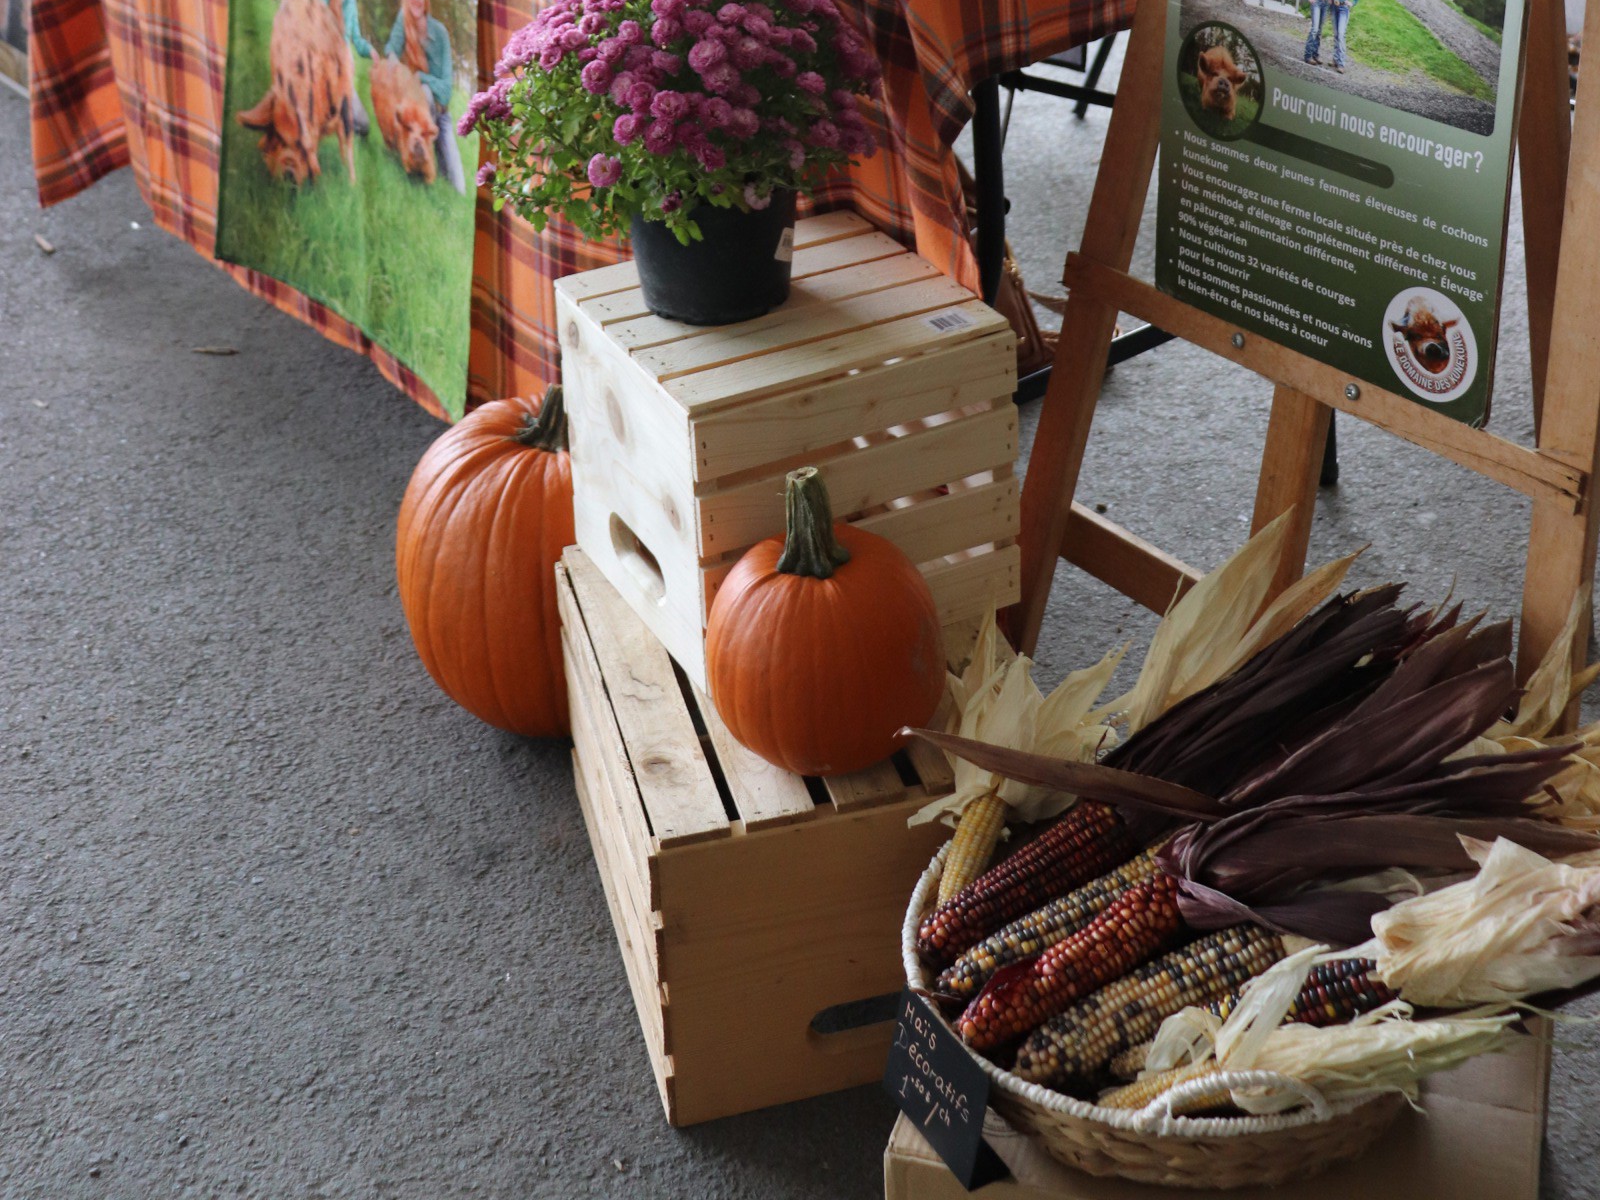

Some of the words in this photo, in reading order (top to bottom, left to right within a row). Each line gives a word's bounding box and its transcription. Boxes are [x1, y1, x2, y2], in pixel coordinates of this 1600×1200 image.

[1183, 146, 1228, 172] kunekune
[1273, 87, 1336, 126] Pourquoi
[1340, 112, 1375, 138] nous
[1380, 126, 1484, 173] encourager?
[1182, 163, 1204, 179] Vous
[1206, 174, 1258, 200] encouragez
[1261, 195, 1279, 208] une
[1281, 200, 1311, 220] ferme
[1313, 212, 1343, 231] locale
[1345, 226, 1377, 244] située
[1380, 239, 1403, 254] près
[1406, 247, 1420, 259] de
[1422, 254, 1447, 270] chez
[1450, 264, 1476, 280] vous
[1184, 130, 1207, 147] Nous
[1211, 142, 1249, 162] sommes
[1254, 156, 1277, 173] deux
[1280, 166, 1314, 186] jeunes
[1319, 179, 1360, 202] femmes
[1365, 196, 1417, 222] éleveuses
[1423, 216, 1436, 229] de
[1442, 225, 1488, 247] cochons
[1179, 211, 1196, 226] 90%
[1199, 221, 1247, 246] végétarien
[1179, 246, 1200, 259] pour
[1202, 253, 1214, 266] les
[1217, 262, 1250, 280] nourrir
[1181, 198, 1191, 207] en
[1194, 203, 1237, 227] pâturage,
[1239, 220, 1301, 250] alimentation
[1304, 244, 1356, 273] différente,
[1182, 179, 1199, 194] Une
[1203, 190, 1244, 211] méthode
[1374, 253, 1428, 281] différente
[1441, 275, 1483, 301] Élevage
[1178, 259, 1200, 276] Nous
[1202, 272, 1240, 293] sommes
[1242, 288, 1300, 318] passionnées
[1303, 314, 1313, 324] et
[1315, 319, 1339, 334] nous
[1342, 330, 1372, 348] avons
[1179, 228, 1202, 244] Nous
[1204, 240, 1245, 262] cultivons
[1247, 256, 1258, 268] 32
[1260, 263, 1299, 284] variétés
[1302, 278, 1313, 290] de
[1316, 285, 1355, 306] courges
[1178, 275, 1186, 286] le
[1188, 279, 1228, 305] bien-être
[1231, 299, 1242, 311] de
[1245, 306, 1261, 318] nos
[1264, 312, 1289, 331] bêtes
[1292, 324, 1297, 334] à
[1300, 330, 1328, 346] coeur
[1400, 356, 1433, 390] DOMAINE
[1435, 380, 1451, 391] DES
[1449, 331, 1466, 384] KUNEKUNE
[904, 1001, 937, 1050] Maïs
[894, 1022, 970, 1124] Décoratifs
